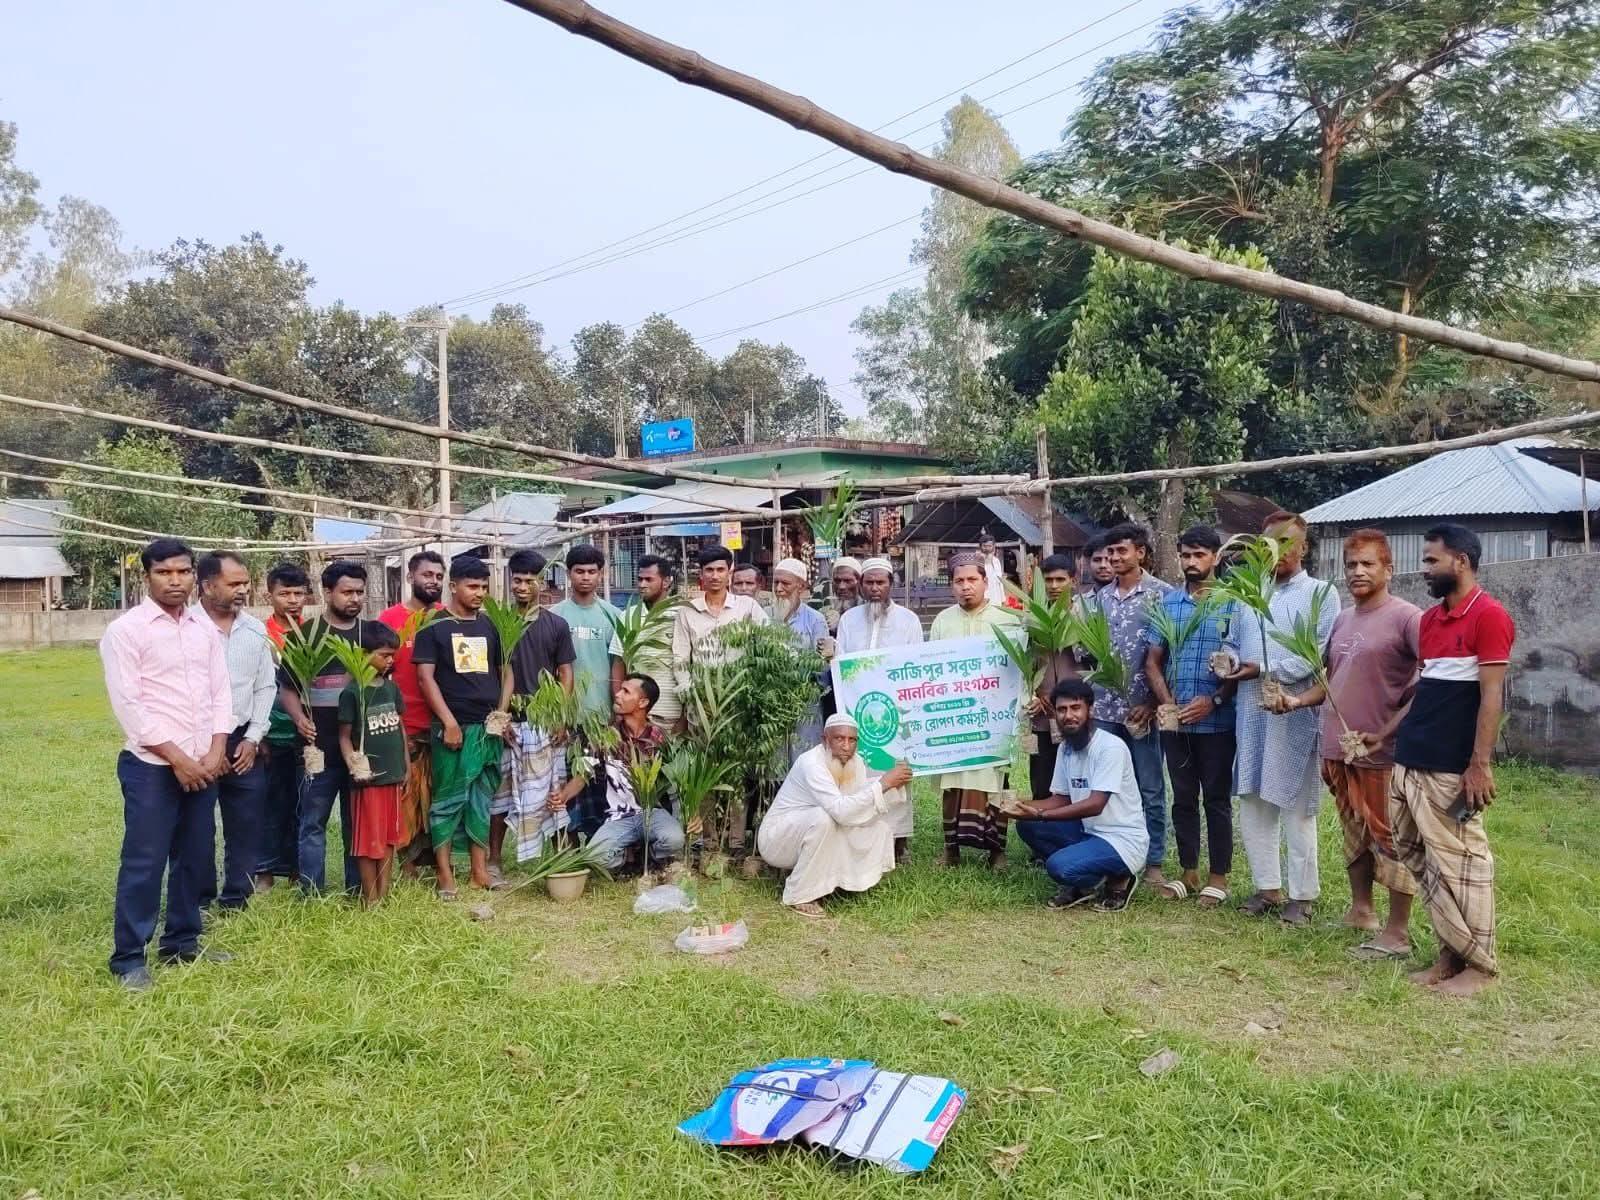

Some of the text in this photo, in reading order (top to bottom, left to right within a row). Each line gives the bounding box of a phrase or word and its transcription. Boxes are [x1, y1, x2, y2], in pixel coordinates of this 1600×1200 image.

[886, 653, 1009, 682] কাজিপুর সবুজ পথ
[896, 674, 1001, 702] মানবিক সংগঠন
[925, 716, 955, 731] রোপণ
